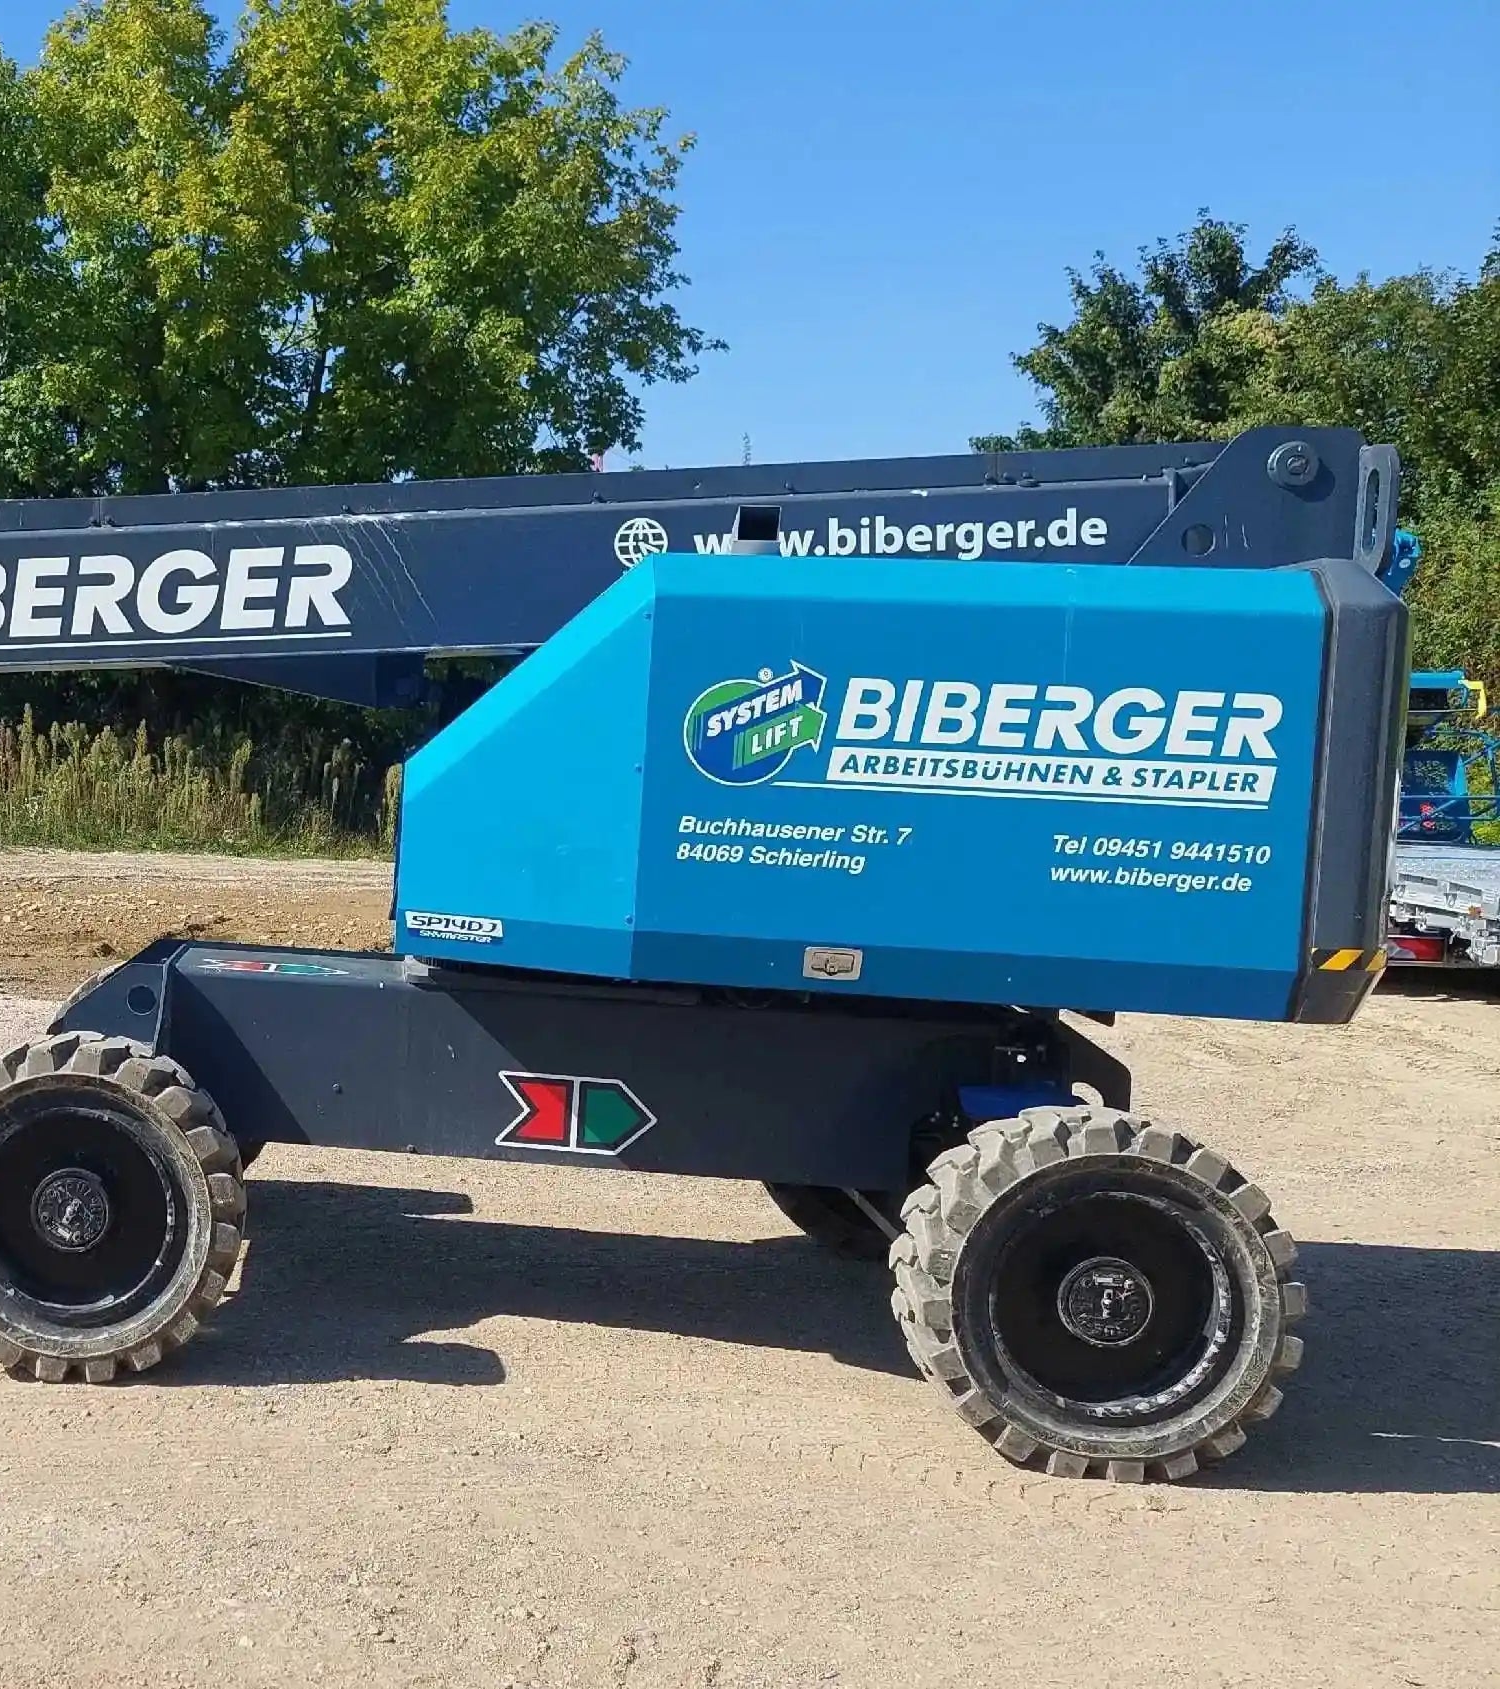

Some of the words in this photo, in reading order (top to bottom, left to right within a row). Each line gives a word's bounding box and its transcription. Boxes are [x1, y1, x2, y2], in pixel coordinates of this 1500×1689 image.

[693, 507, 1108, 561] ww.biberger.de
[706, 679, 803, 737] SYSTEM
[835, 677, 1284, 759] BIBERGER
[751, 715, 803, 755] LIFT
[839, 753, 1094, 785] ARBEITSBÜHNEN
[1101, 766, 1123, 786] &
[1130, 767, 1260, 793] STAPLER
[678, 815, 846, 842] Buchhausener
[850, 823, 889, 845] Str.
[896, 827, 913, 846] 7
[676, 842, 744, 863] 84069
[748, 845, 866, 875] Schierling
[1053, 834, 1088, 855] Tel
[1092, 837, 1163, 859] 09451
[1169, 841, 1271, 865] 9441510
[1049, 865, 1252, 893] www.biberger.de
[411, 914, 498, 933] SP14DJ
